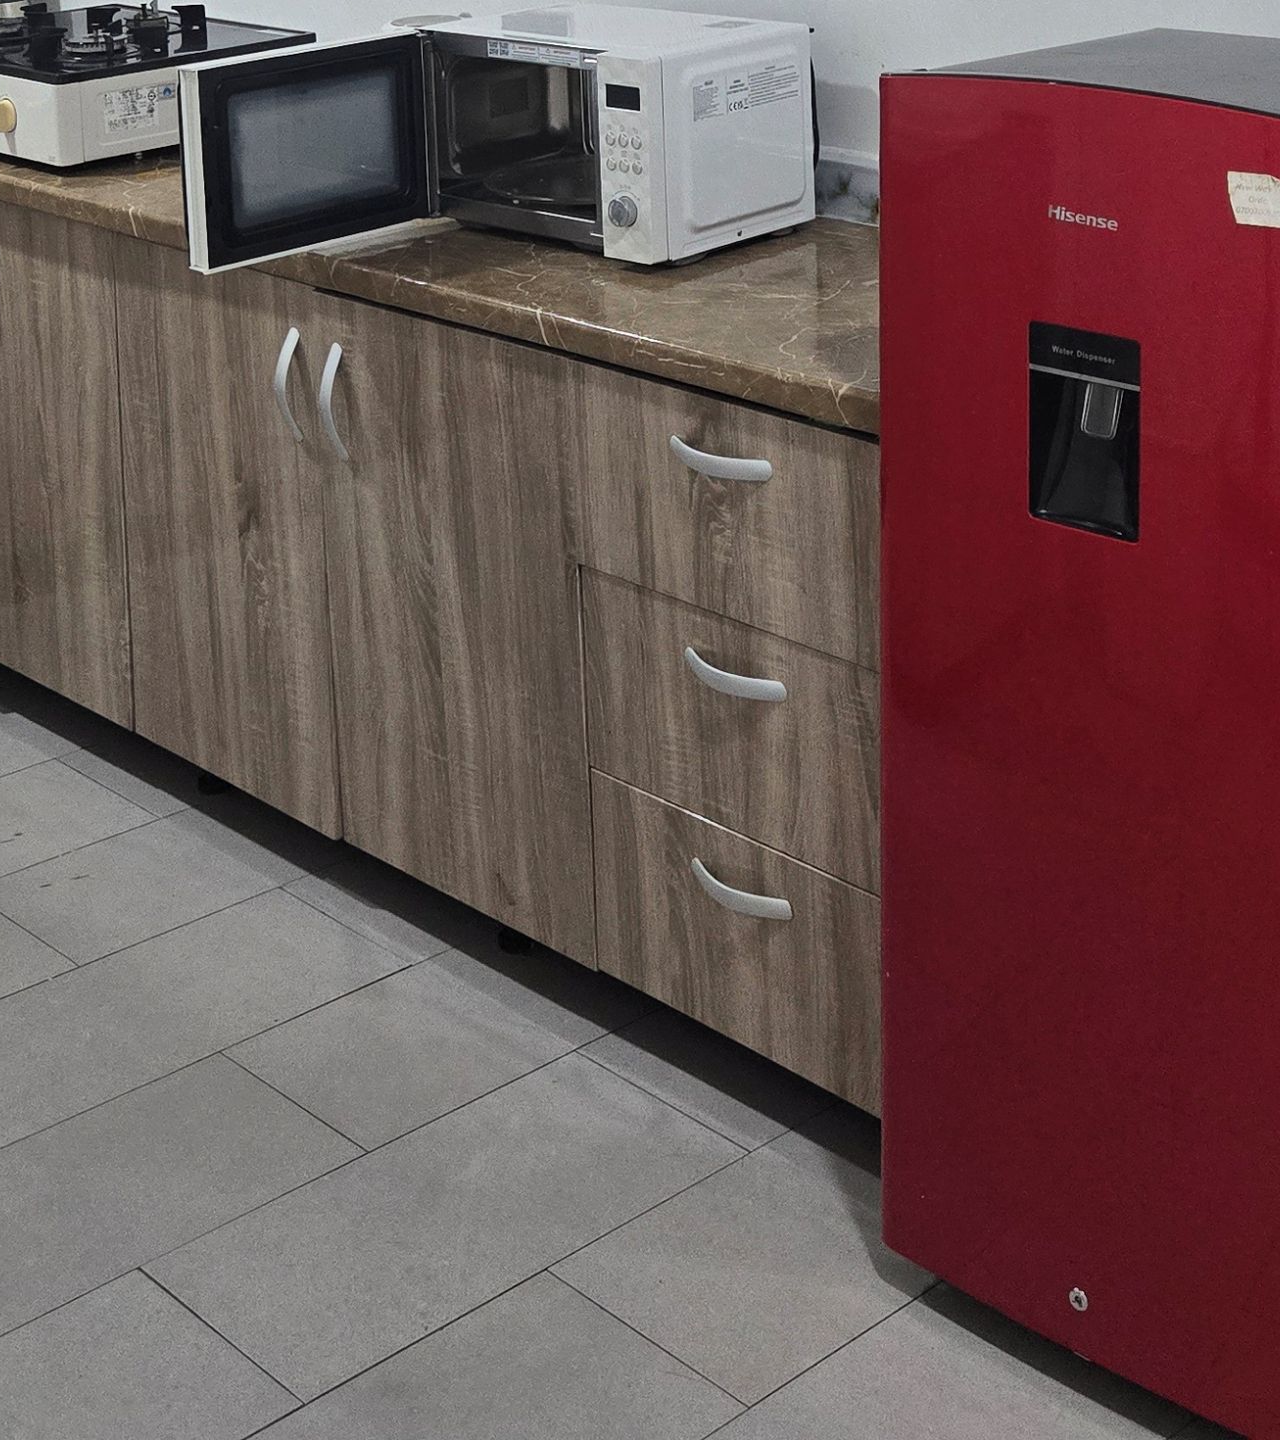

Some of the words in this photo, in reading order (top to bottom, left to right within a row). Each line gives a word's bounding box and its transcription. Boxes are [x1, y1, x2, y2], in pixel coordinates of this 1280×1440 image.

[1047, 204, 1119, 232] Hisense
[1051, 345, 1074, 357] Water
[1076, 349, 1116, 365] Dispenser
